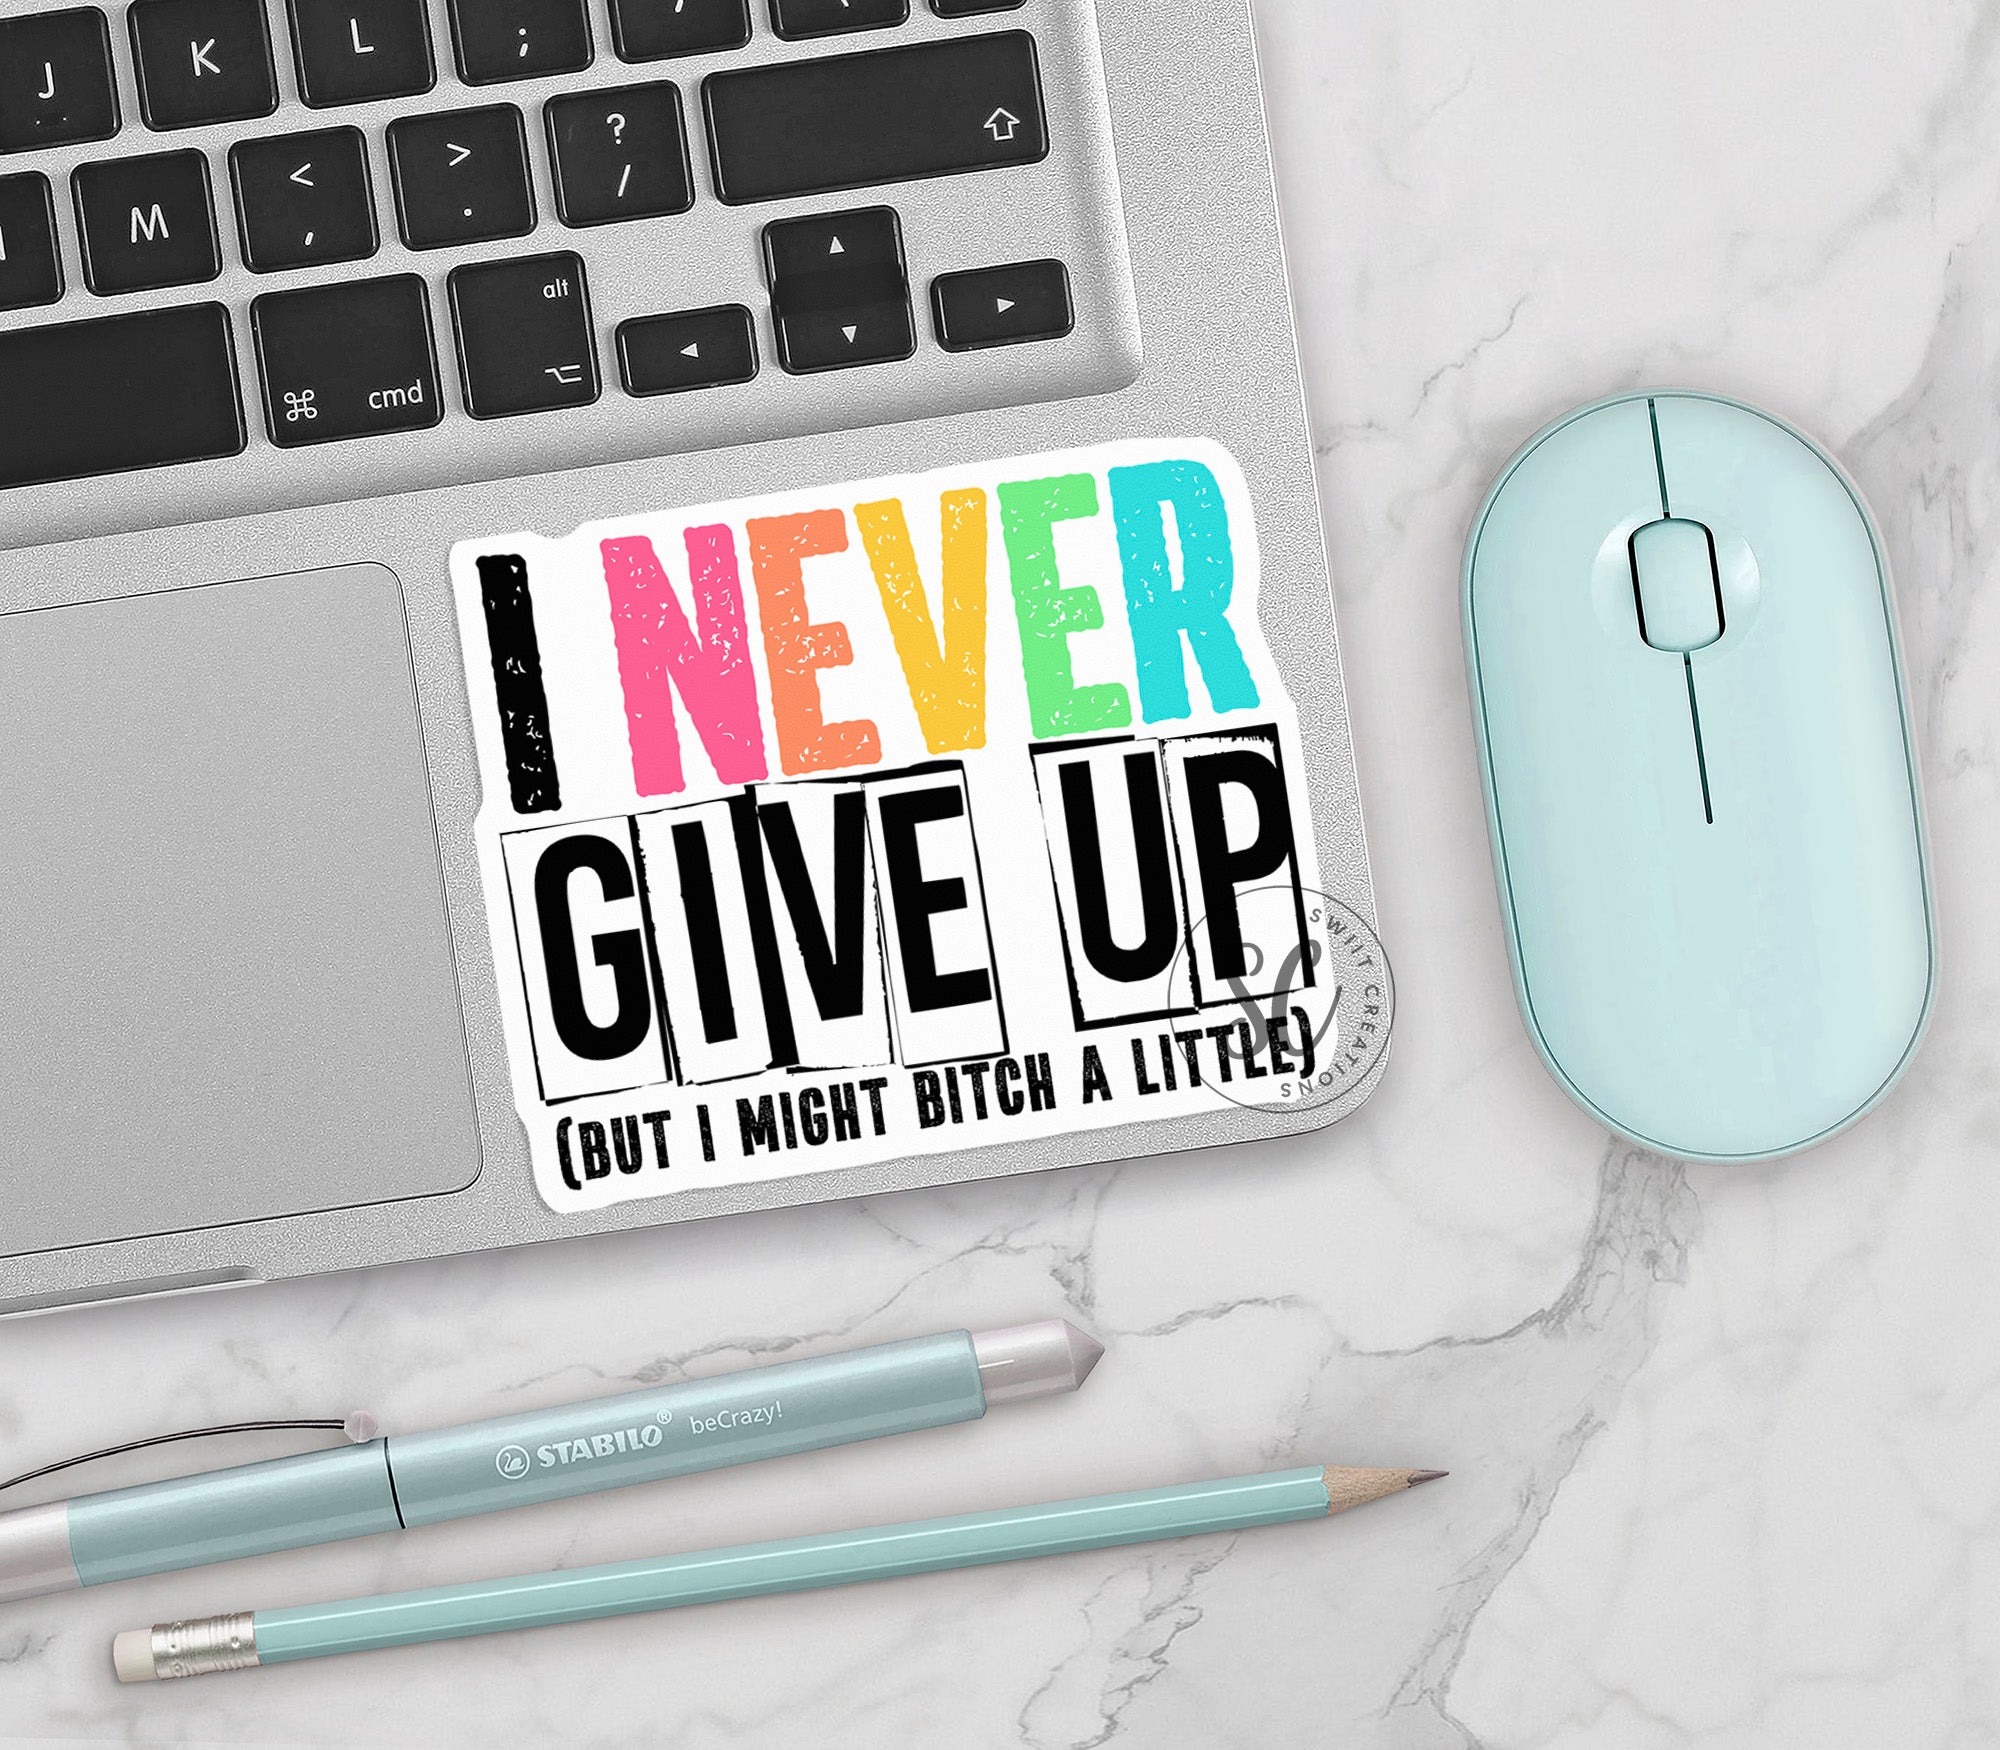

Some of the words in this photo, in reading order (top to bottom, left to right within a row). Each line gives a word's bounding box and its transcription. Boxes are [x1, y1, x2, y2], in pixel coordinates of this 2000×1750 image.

[350, 18, 375, 54] L
[518, 28, 529, 58] ;
[190, 38, 221, 77] K
[38, 61, 55, 99] J
[606, 113, 626, 145] ?
[130, 203, 170, 244] M
[542, 278, 569, 299] alt
[368, 378, 424, 410] cmd
[475, 553, 562, 814] I
[599, 459, 1261, 798] NEVER
[534, 784, 993, 1062] GIVE
[1058, 750, 1293, 984] UP
[555, 1109, 672, 1192] (BUT
[696, 1103, 717, 1162] I
[734, 1077, 889, 1158] MIGHT
[911, 1052, 1057, 1130] BITCH
[1082, 1045, 1113, 1104] A
[1131, 1005, 1316, 1097] LITTLE)
[689, 1400, 783, 1435] beCrazy!
